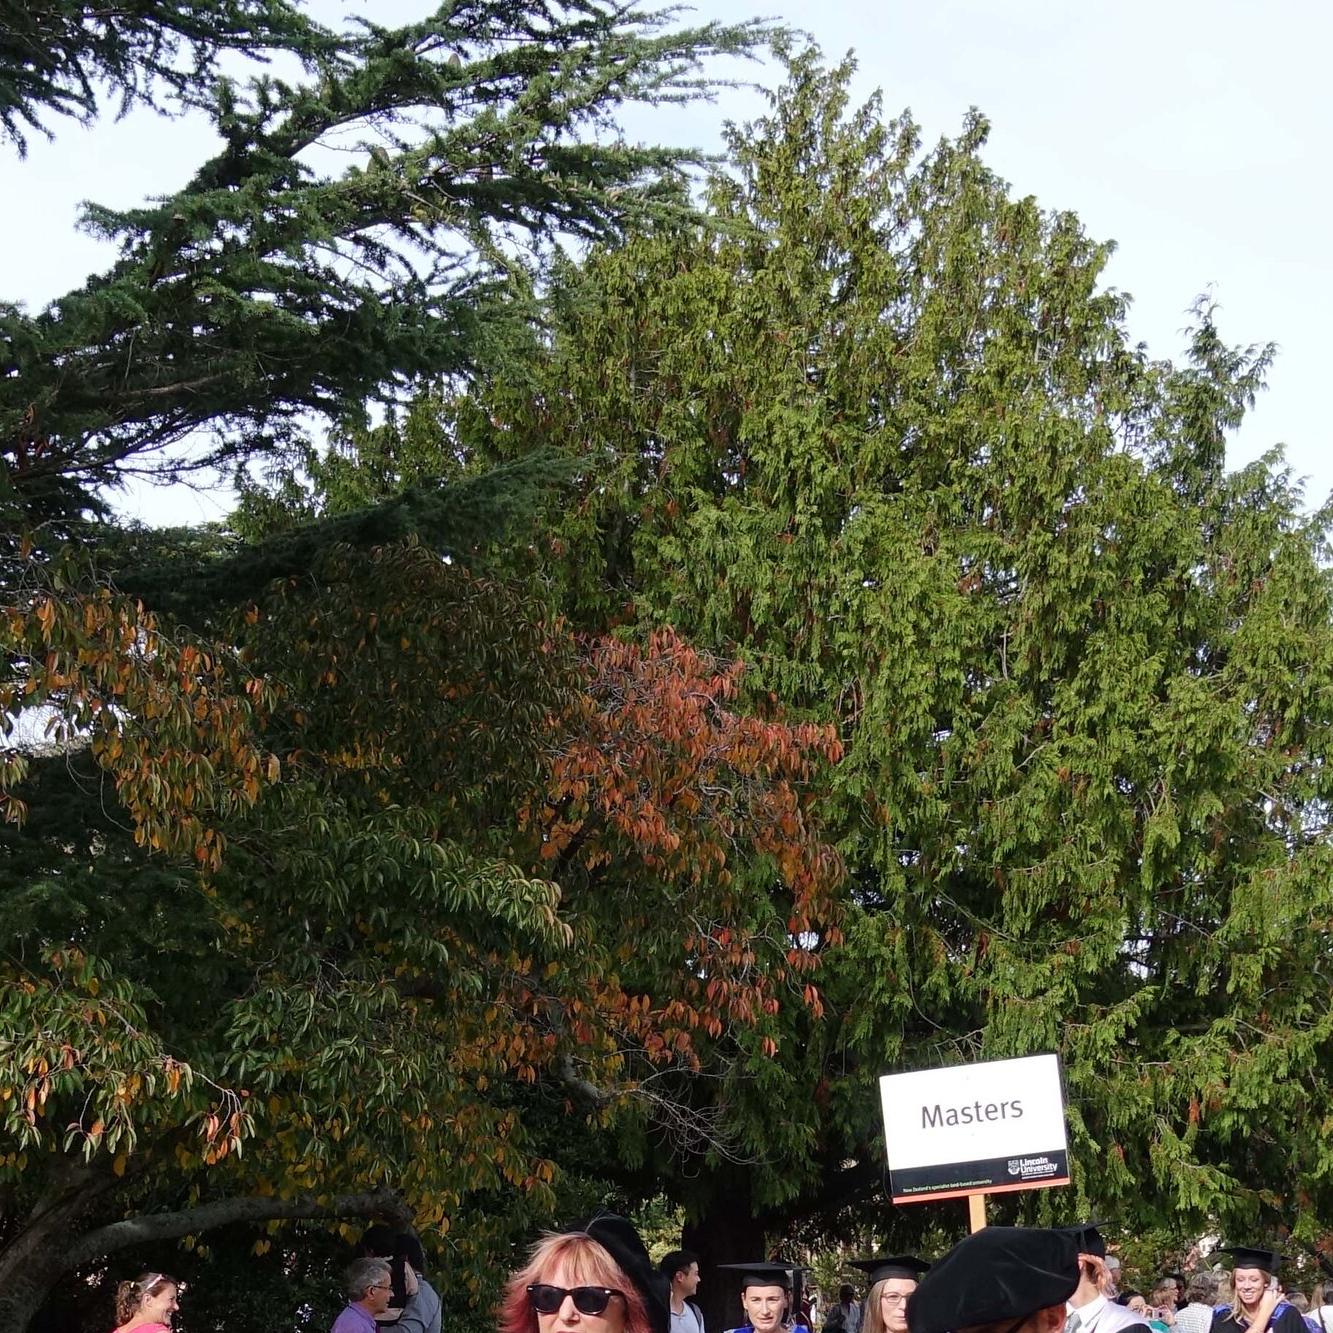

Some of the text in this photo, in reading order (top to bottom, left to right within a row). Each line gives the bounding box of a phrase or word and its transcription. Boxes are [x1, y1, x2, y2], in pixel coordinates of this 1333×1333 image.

[922, 1099, 1024, 1129] Masters
[1020, 1157, 1048, 1166] Lincoln
[1020, 1163, 1058, 1173] University
